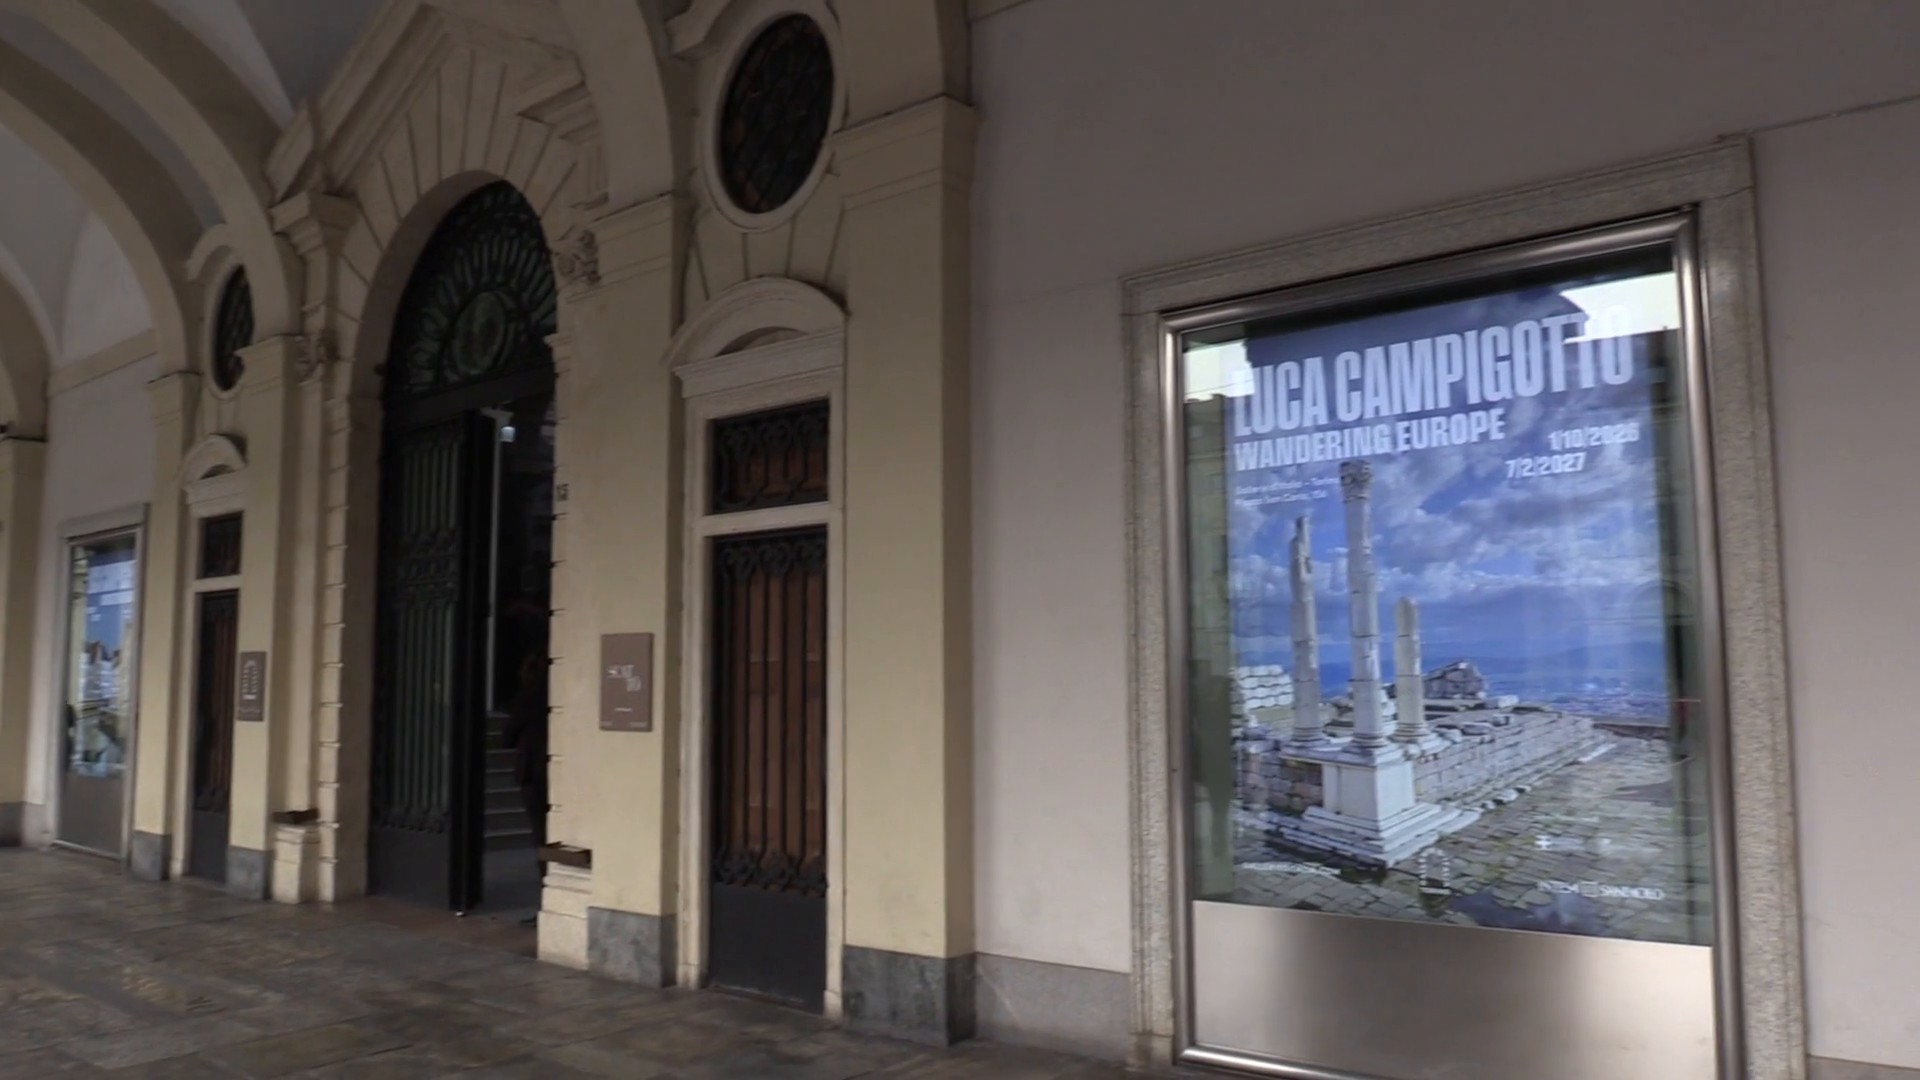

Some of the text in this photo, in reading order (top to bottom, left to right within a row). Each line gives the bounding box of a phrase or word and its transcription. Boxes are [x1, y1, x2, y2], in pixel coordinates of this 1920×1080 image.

[1233, 304, 1635, 438] LUCA CAMPIGOTTO
[1234, 407, 1506, 472] WANDERING EUROPE
